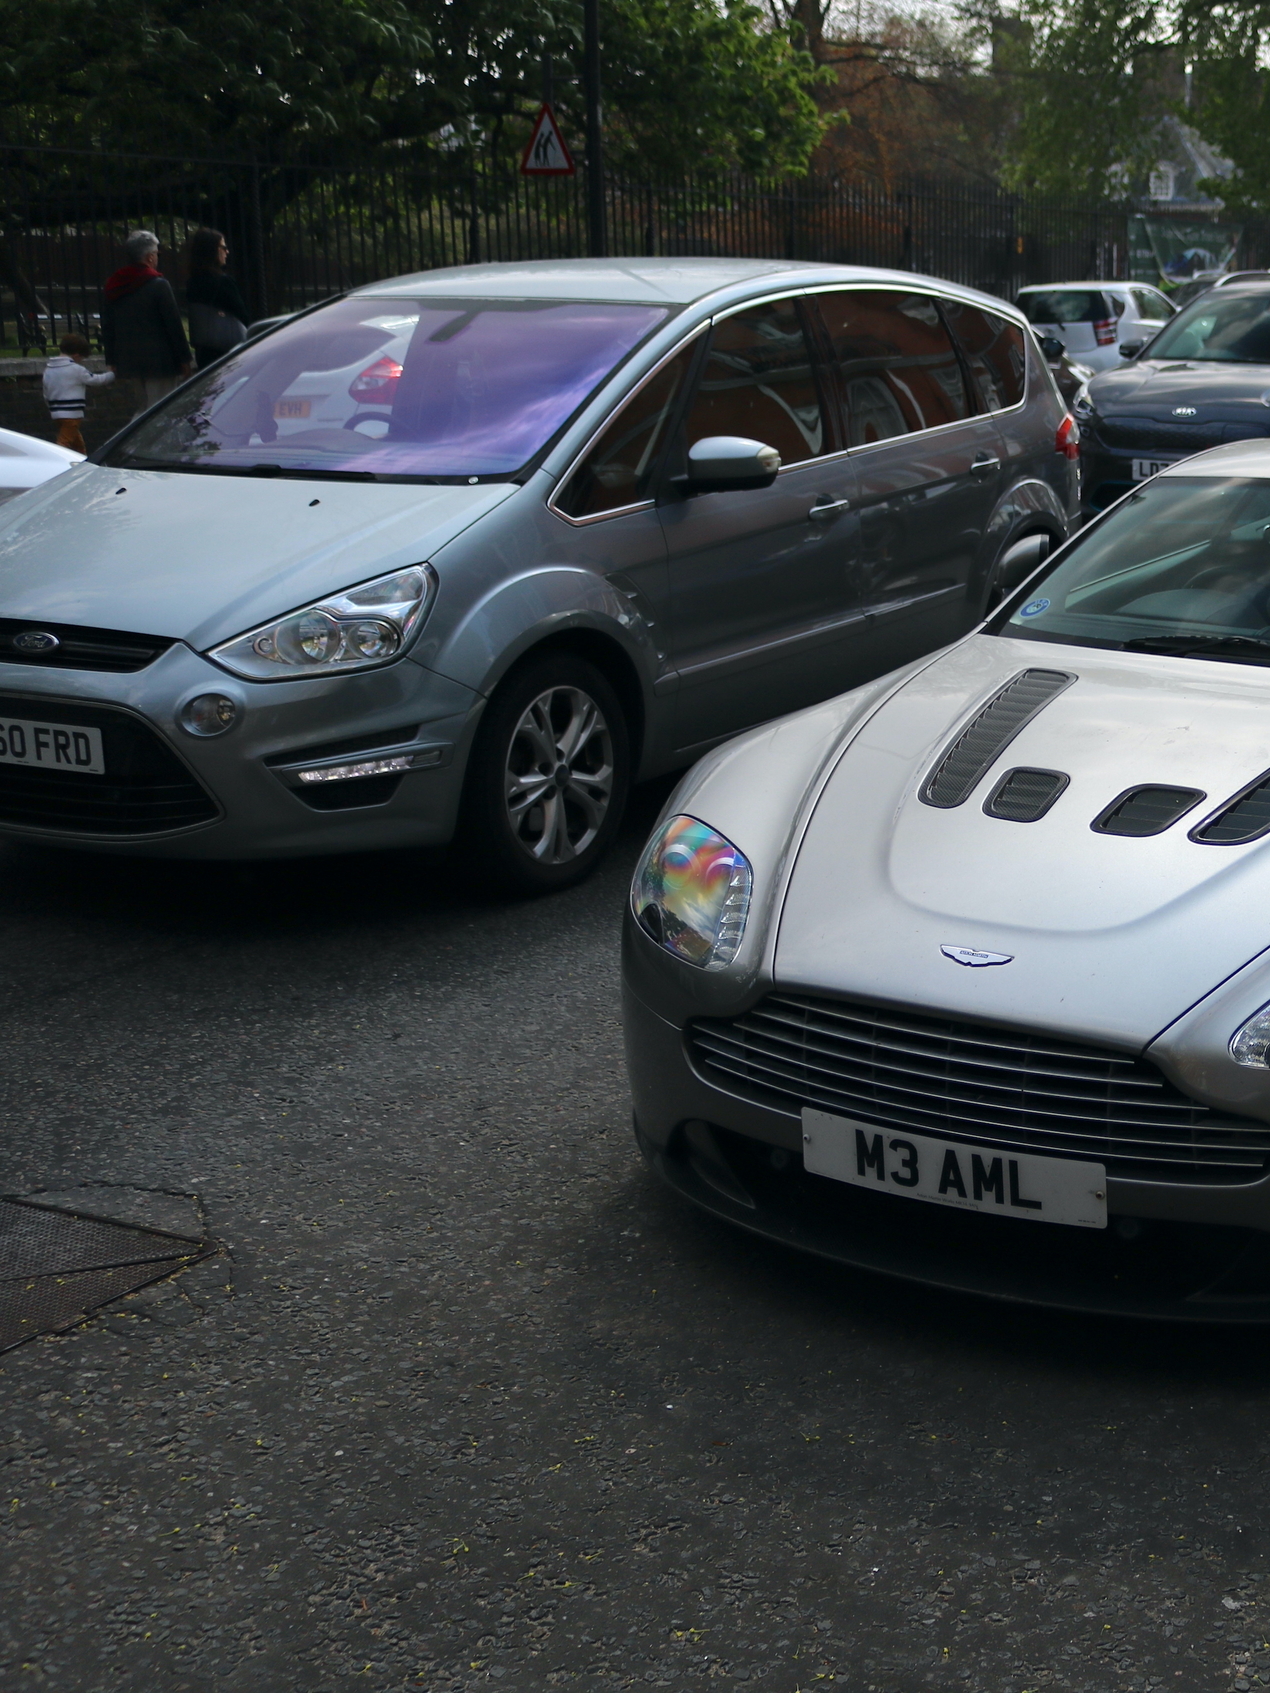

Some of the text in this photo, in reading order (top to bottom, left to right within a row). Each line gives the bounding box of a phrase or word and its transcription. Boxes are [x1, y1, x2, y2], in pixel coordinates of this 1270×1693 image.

[20, 634, 48, 648] Ford
[33, 727, 92, 767] FRD
[855, 1128, 1042, 1210] M3 AML
